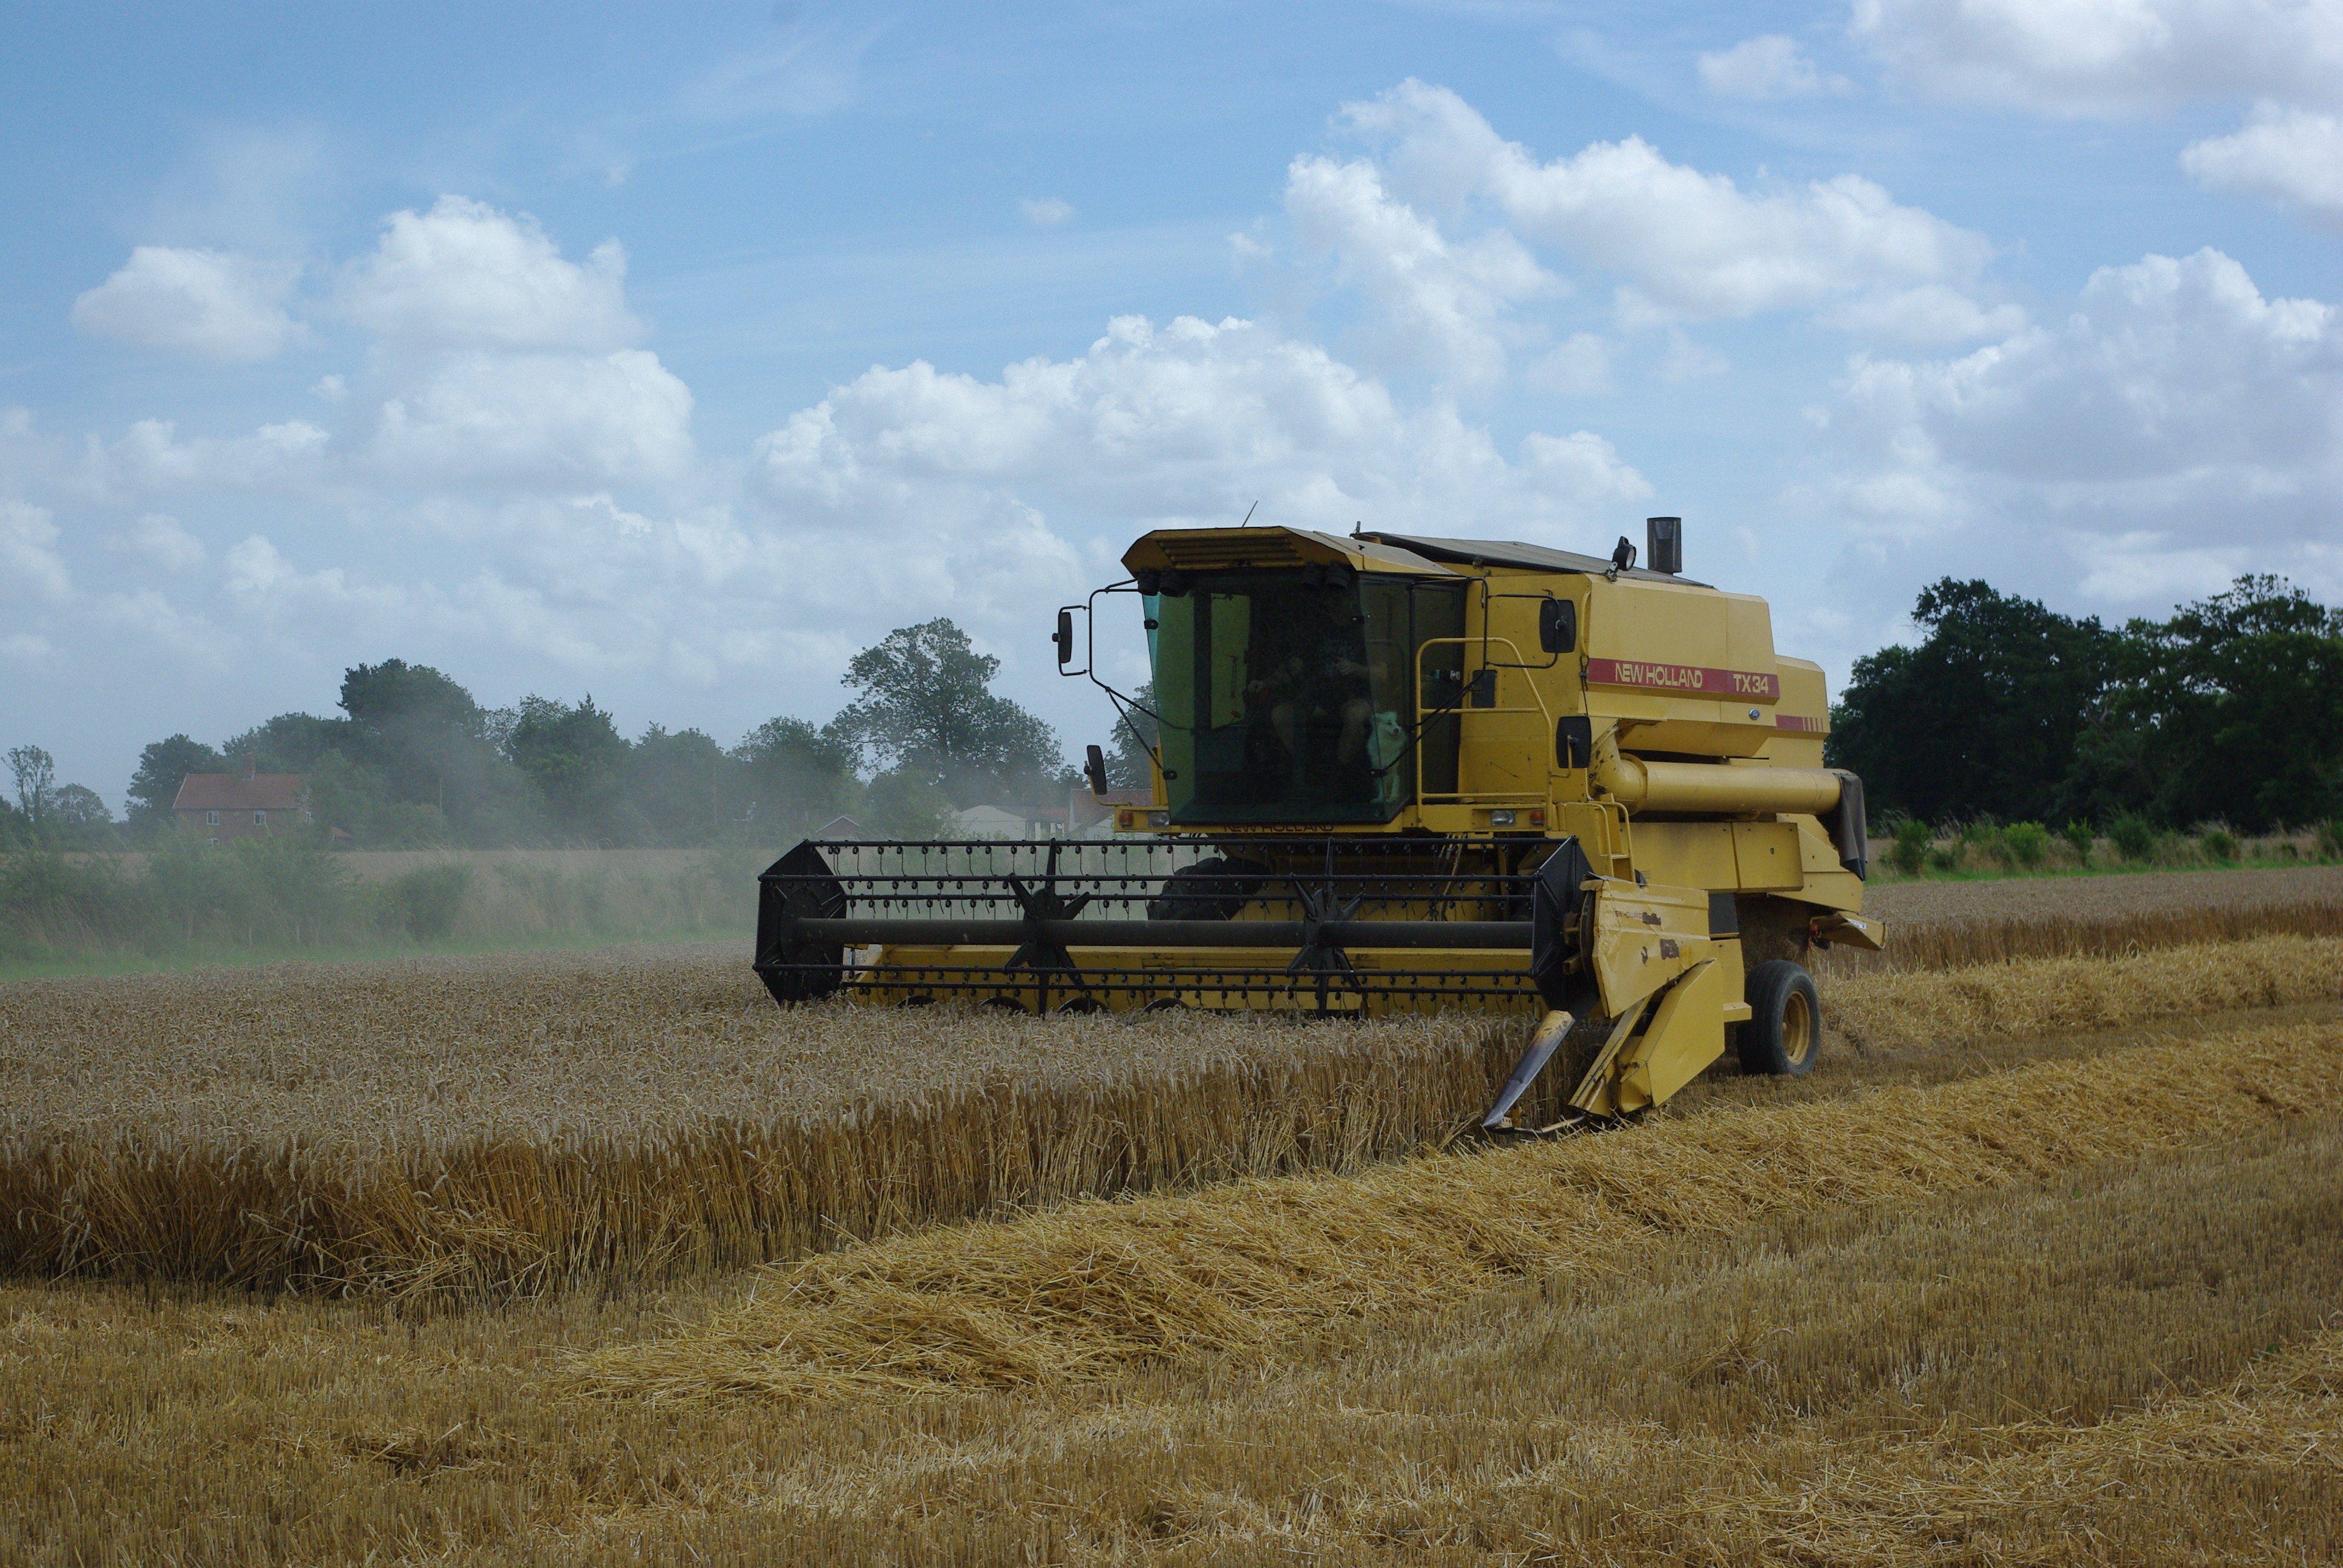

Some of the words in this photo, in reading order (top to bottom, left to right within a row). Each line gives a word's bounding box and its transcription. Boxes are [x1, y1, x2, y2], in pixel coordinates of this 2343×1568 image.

[1615, 663, 1643, 683] NEW
[1646, 666, 1703, 688] HOLLAND
[1733, 673, 1769, 694] TX34
